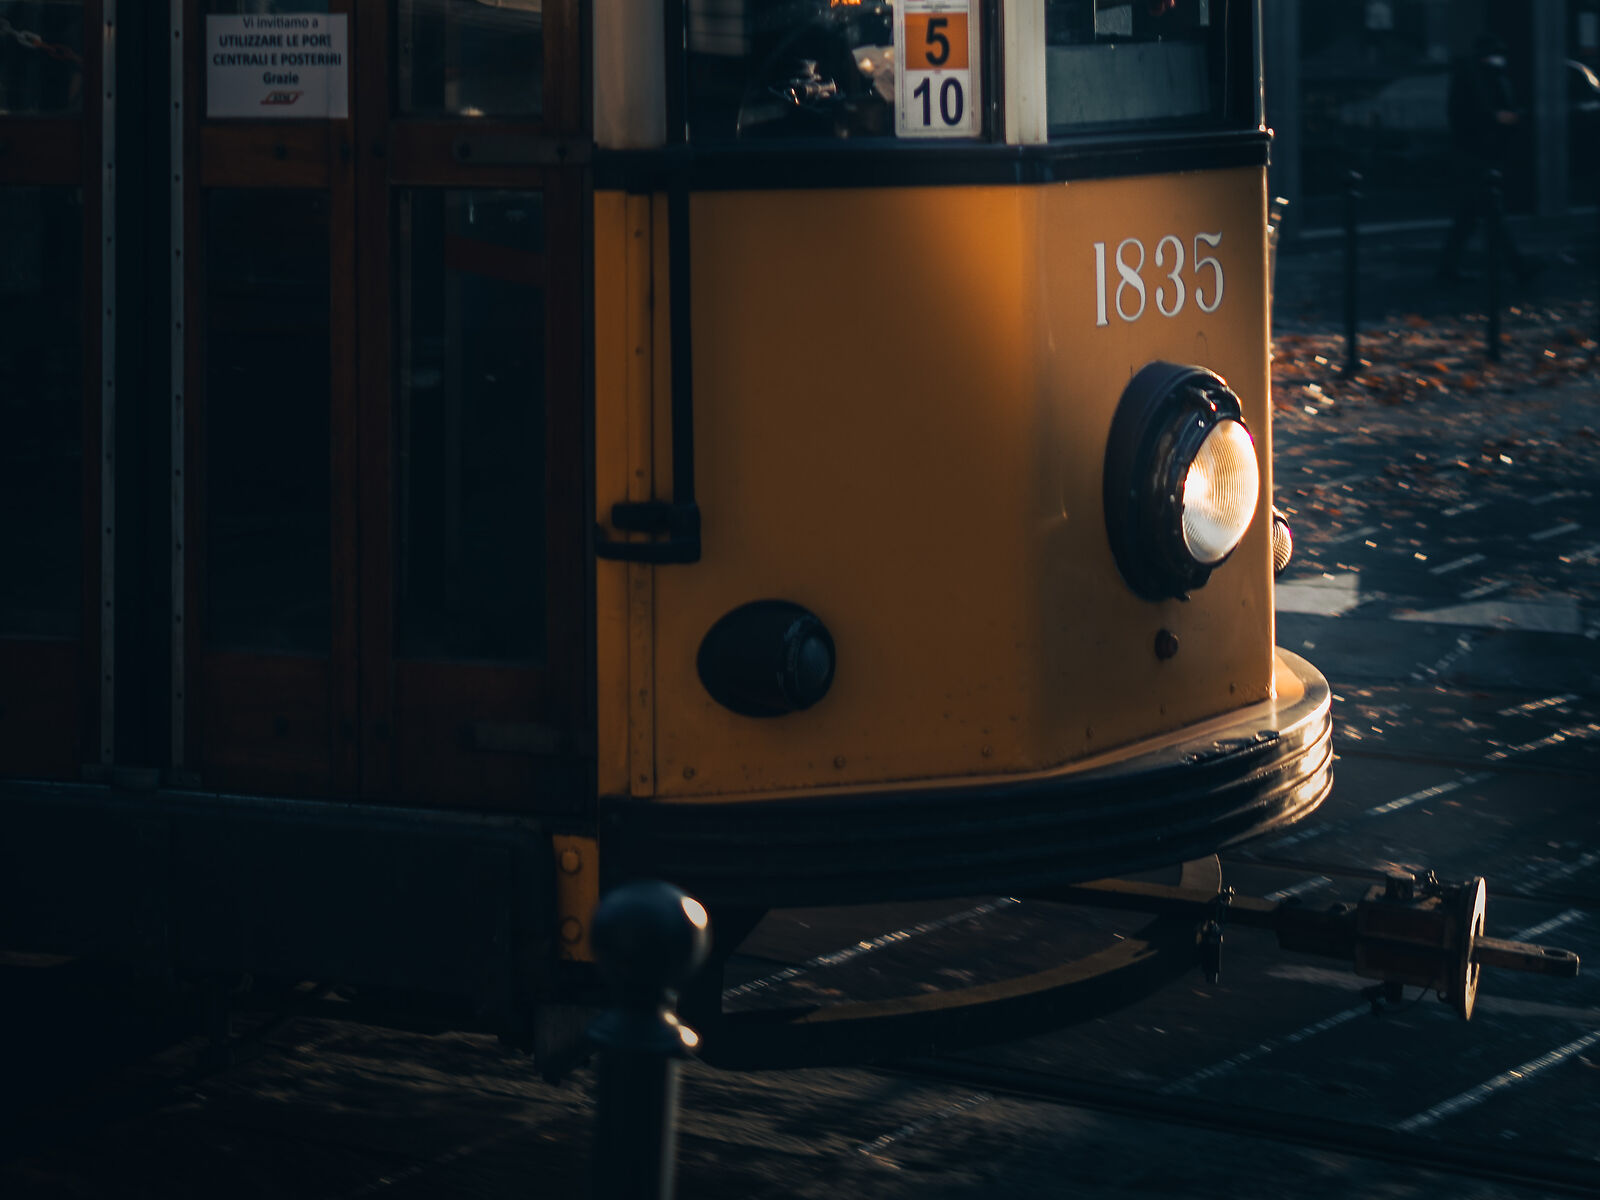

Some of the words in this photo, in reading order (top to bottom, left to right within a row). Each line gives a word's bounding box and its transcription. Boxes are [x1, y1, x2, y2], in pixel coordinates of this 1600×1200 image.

[243, 17, 254, 28] Vi
[257, 17, 309, 29] invitiamo
[218, 34, 283, 48] UTILIZZARE
[286, 34, 299, 48] LE
[925, 17, 950, 66] 5
[213, 53, 268, 66] CENTRALI
[271, 53, 278, 66] E
[263, 71, 299, 85] Grazie
[913, 76, 964, 126] 10
[1093, 231, 1225, 328] 1835
